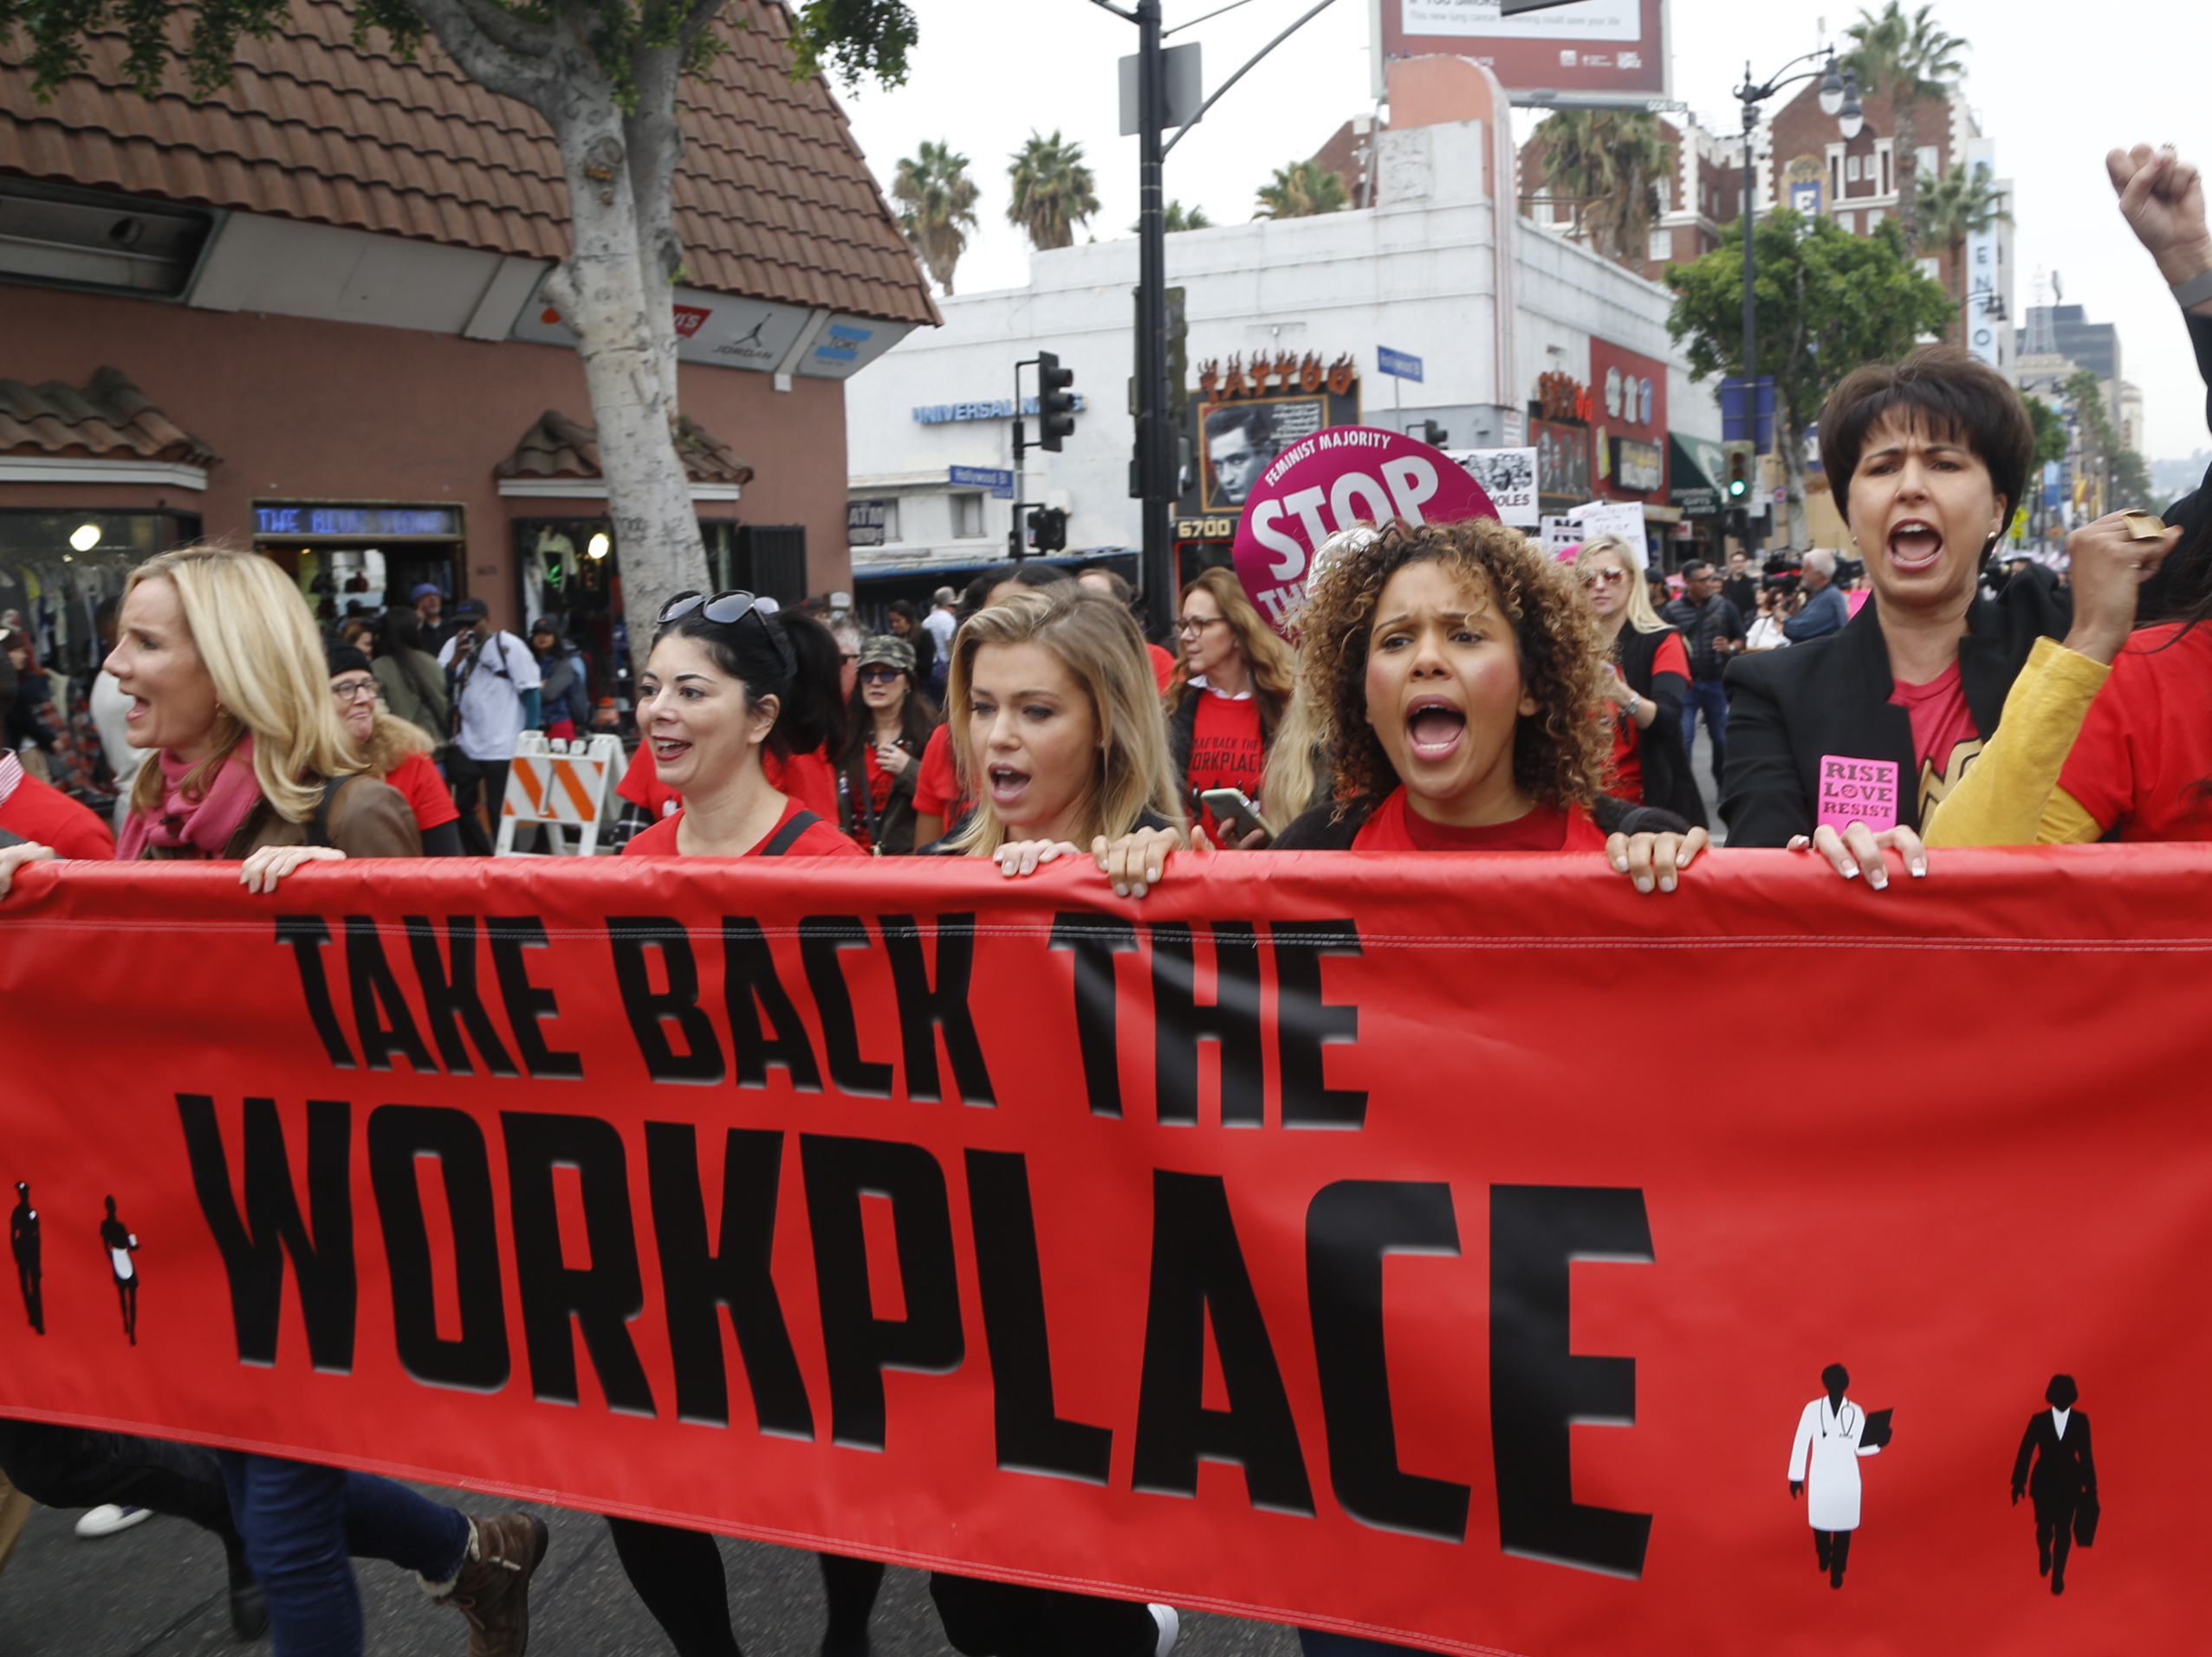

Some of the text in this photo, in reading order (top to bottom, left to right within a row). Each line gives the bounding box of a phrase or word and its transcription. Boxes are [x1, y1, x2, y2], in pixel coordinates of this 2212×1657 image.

[710, 345, 774, 360] JORDAN
[1197, 348, 1354, 405] TATTOO
[912, 398, 1016, 424] UNIVERSAL
[1264, 430, 1391, 488] FEMINIST MAJORITY
[955, 468, 996, 485] Hollywood
[256, 508, 301, 534] THE
[1177, 520, 1230, 538] 6700
[1251, 455, 1439, 581] STOP
[1256, 582, 1309, 626] TH
[1193, 737, 1260, 751] AKE BACK THE
[1191, 752, 1266, 773] ORKPLACE
[1826, 762, 1893, 783] RISE
[1824, 782, 1892, 802] LOVE
[1823, 801, 1892, 818] RESIST
[274, 911, 1369, 1130] TAKE BACK THE
[175, 1093, 1655, 1580] WORKPLACE
